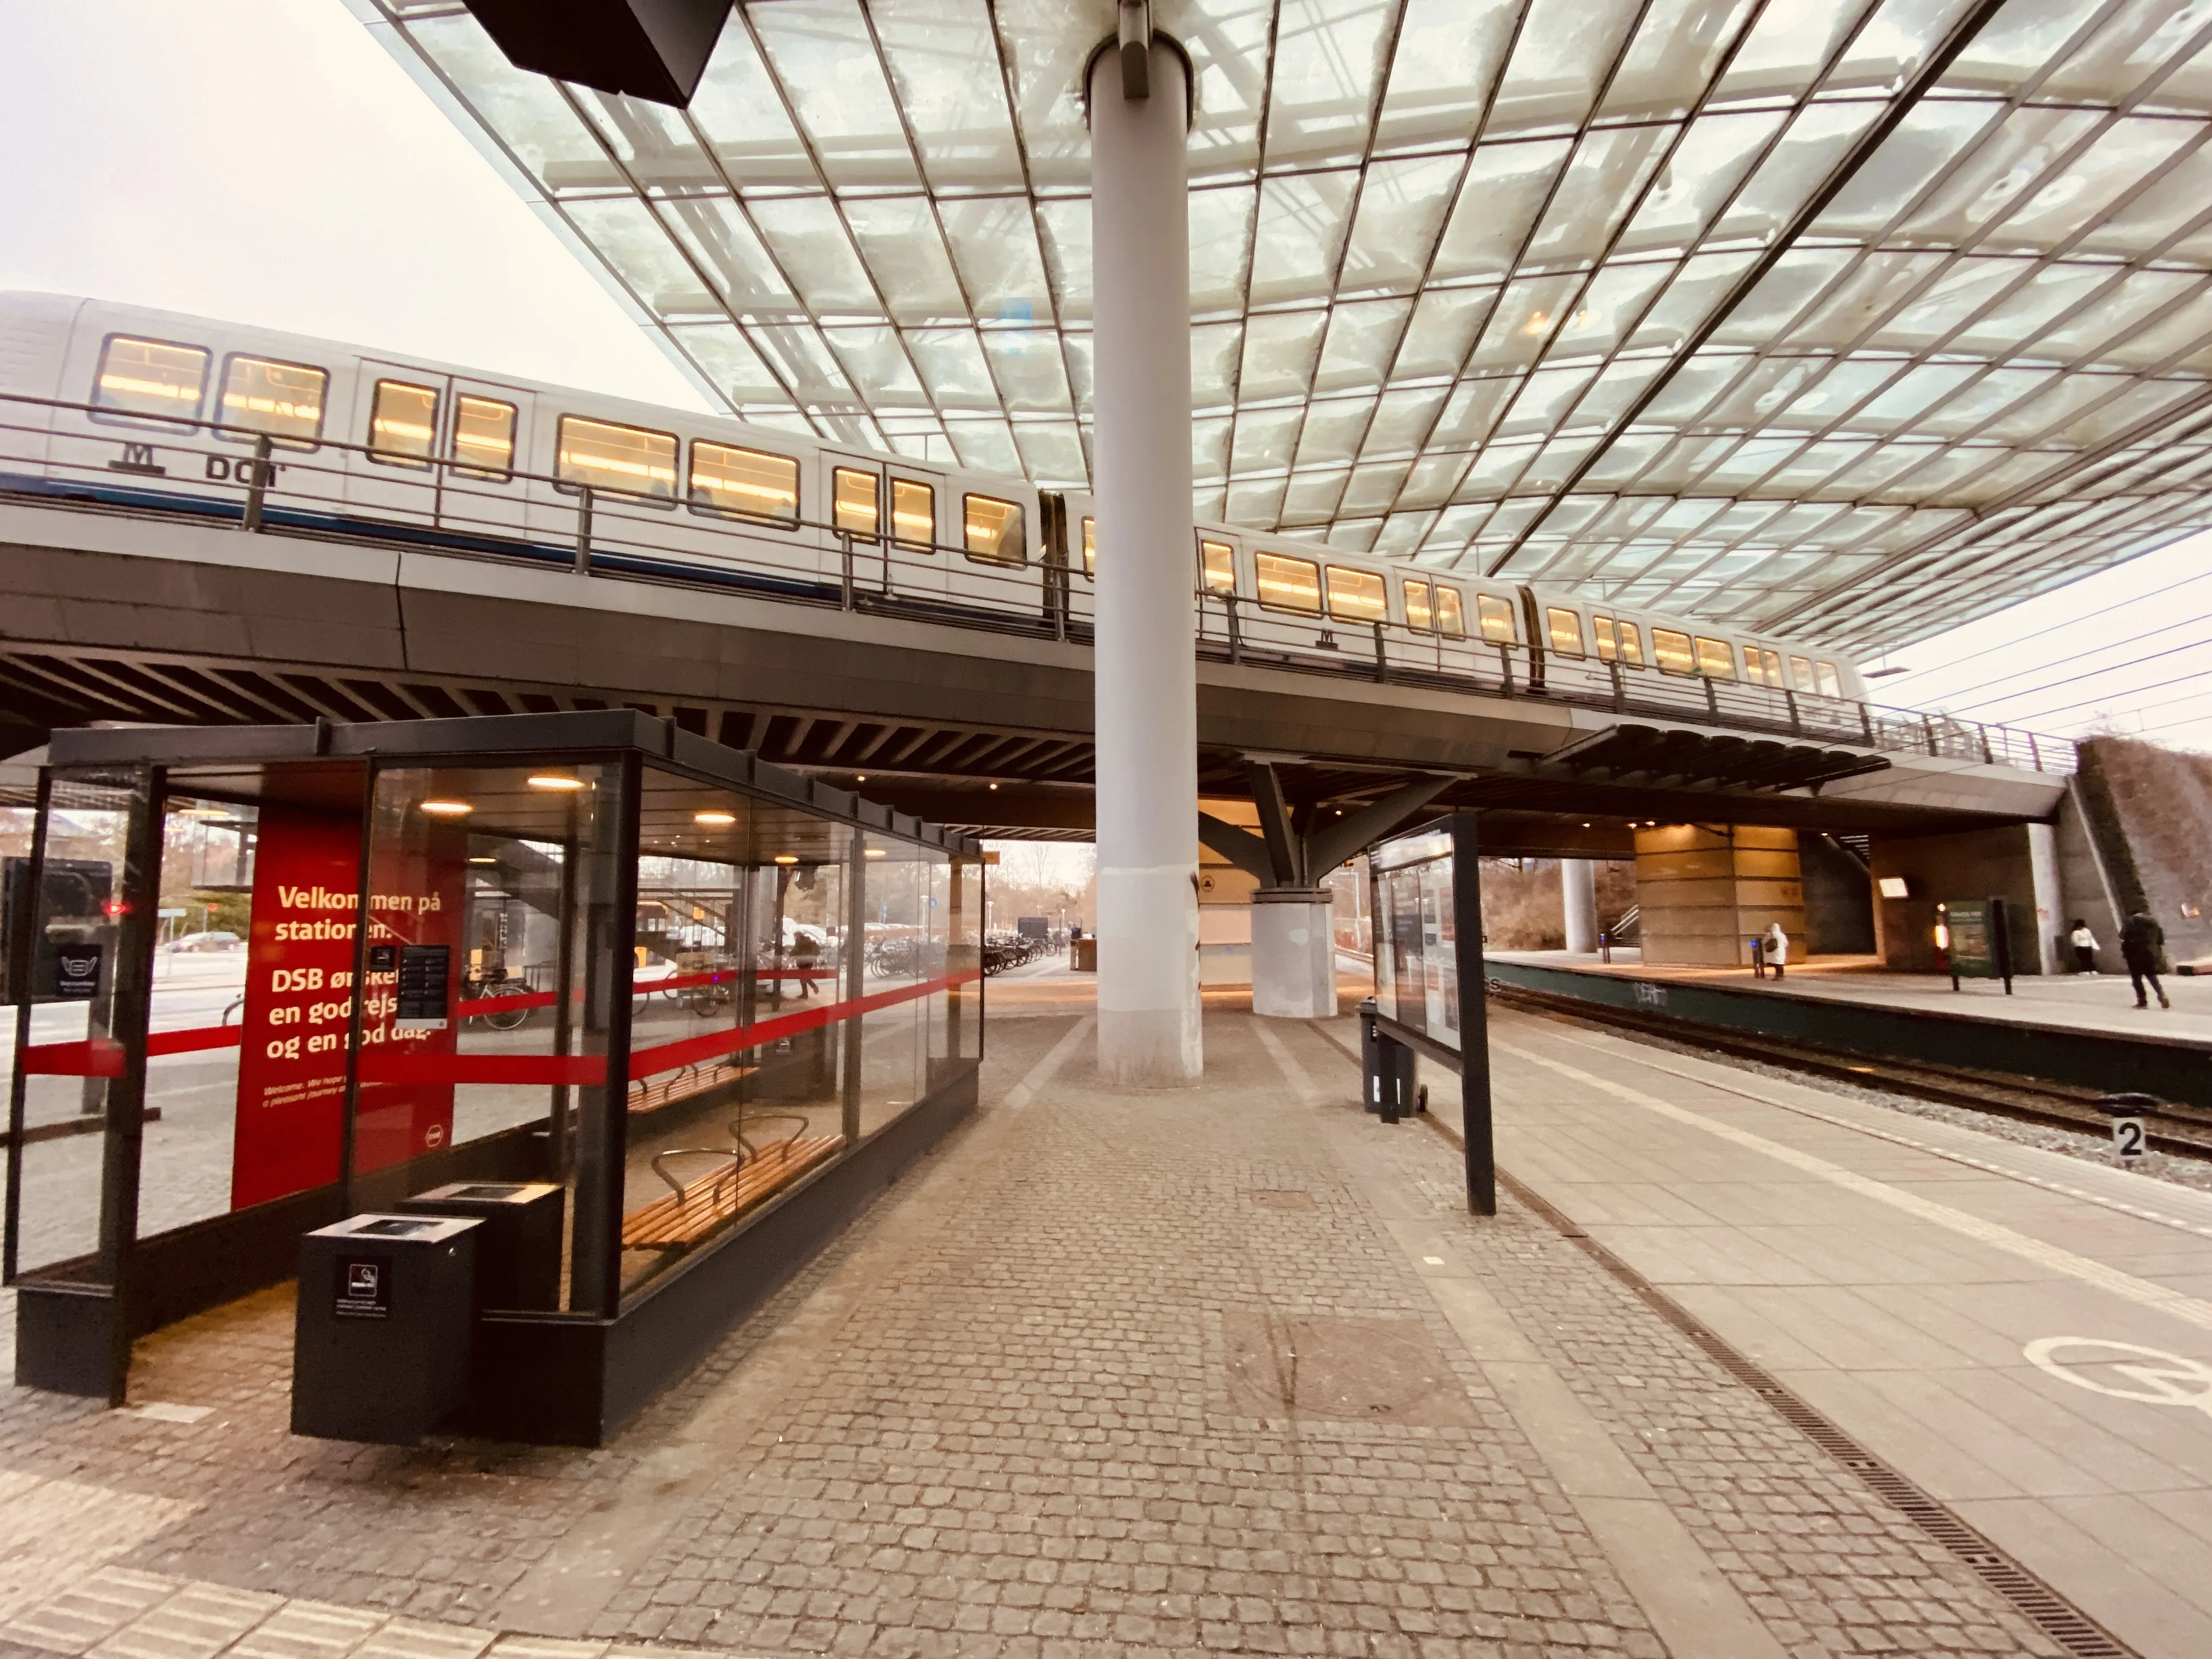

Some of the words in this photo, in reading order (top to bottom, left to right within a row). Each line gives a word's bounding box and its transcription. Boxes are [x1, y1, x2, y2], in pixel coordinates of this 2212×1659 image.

[419, 891, 441, 915] på
[272, 968, 324, 992] DSB
[1490, 979, 1501, 990] S
[269, 1006, 301, 1025] en
[308, 996, 352, 1025] god
[364, 993, 398, 1018] ejs
[267, 1036, 300, 1059] og
[307, 1033, 336, 1053] en
[2119, 1122, 2142, 1156] 2
